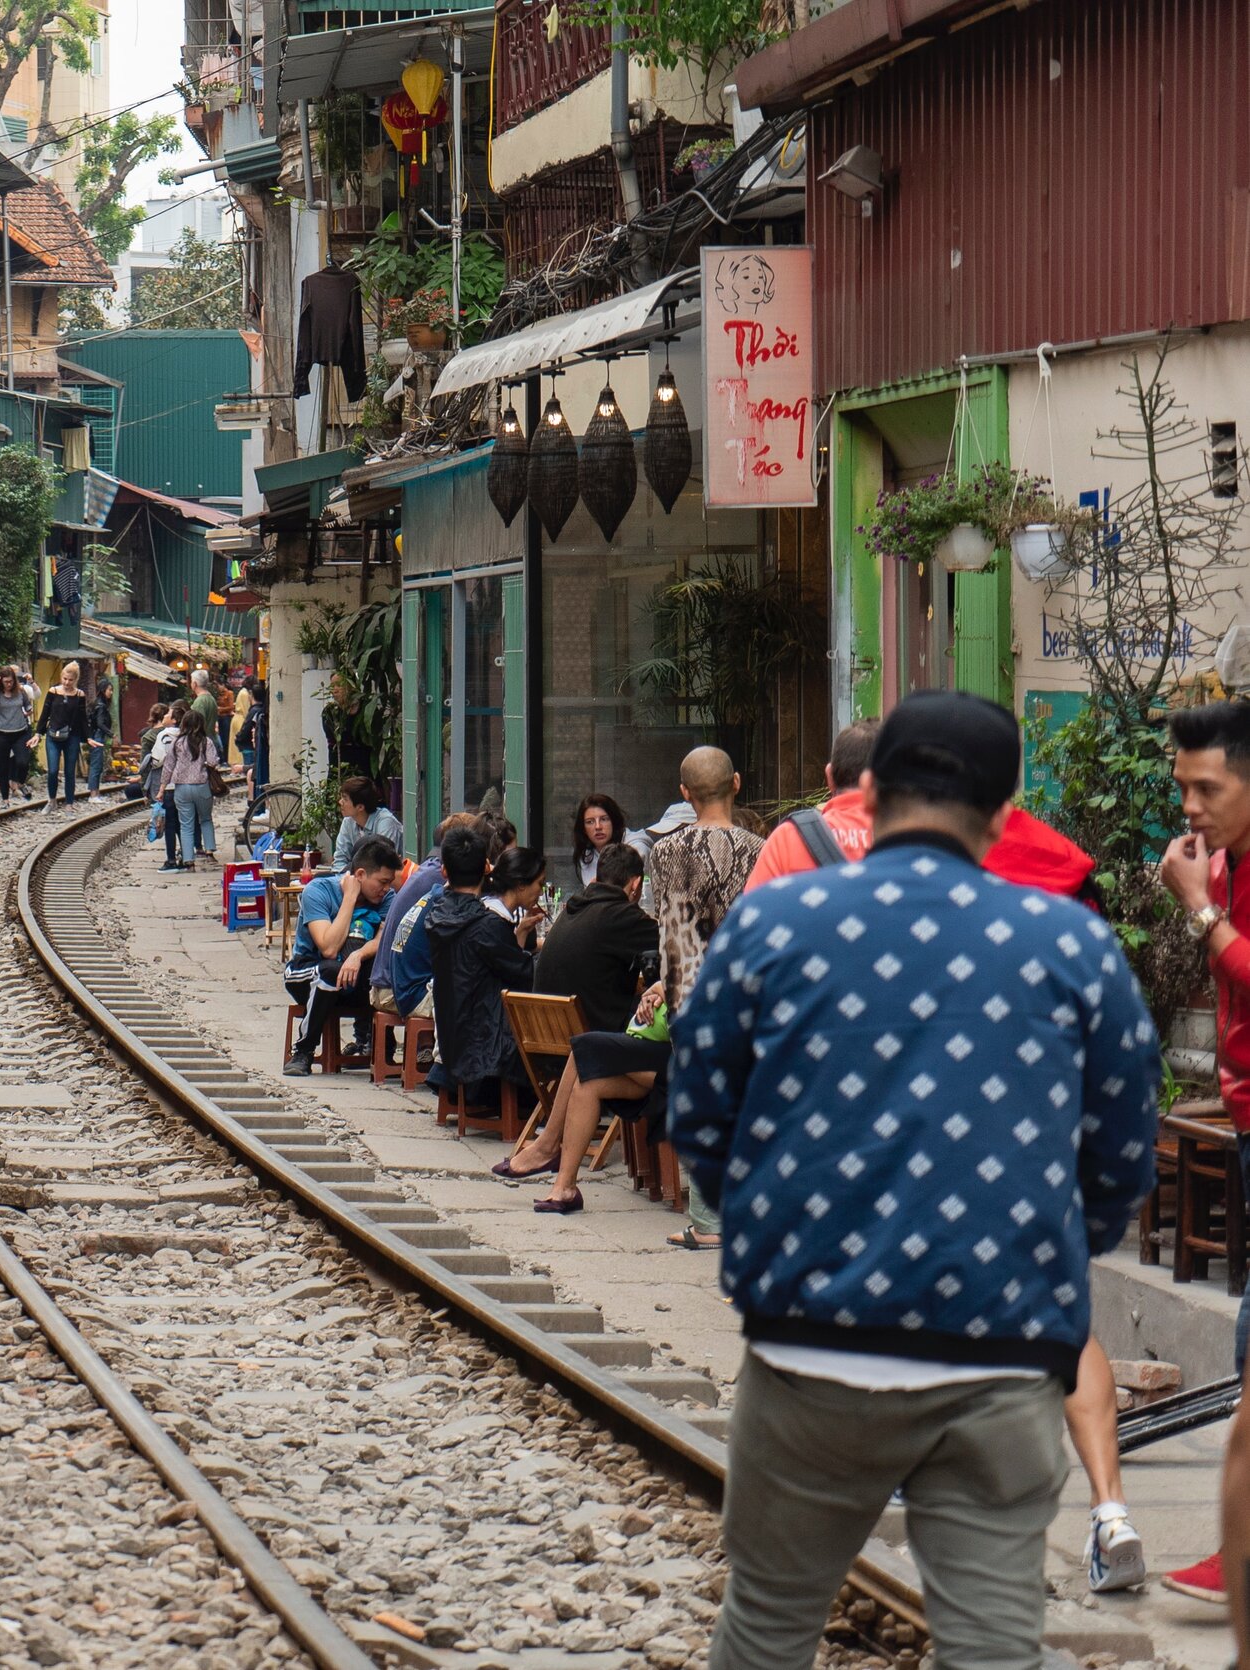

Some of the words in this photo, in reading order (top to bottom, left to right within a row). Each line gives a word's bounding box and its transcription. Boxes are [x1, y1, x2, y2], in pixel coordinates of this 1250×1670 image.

[723, 319, 800, 367] Thời
[715, 378, 809, 461] Trang
[724, 436, 784, 487] Tóc
